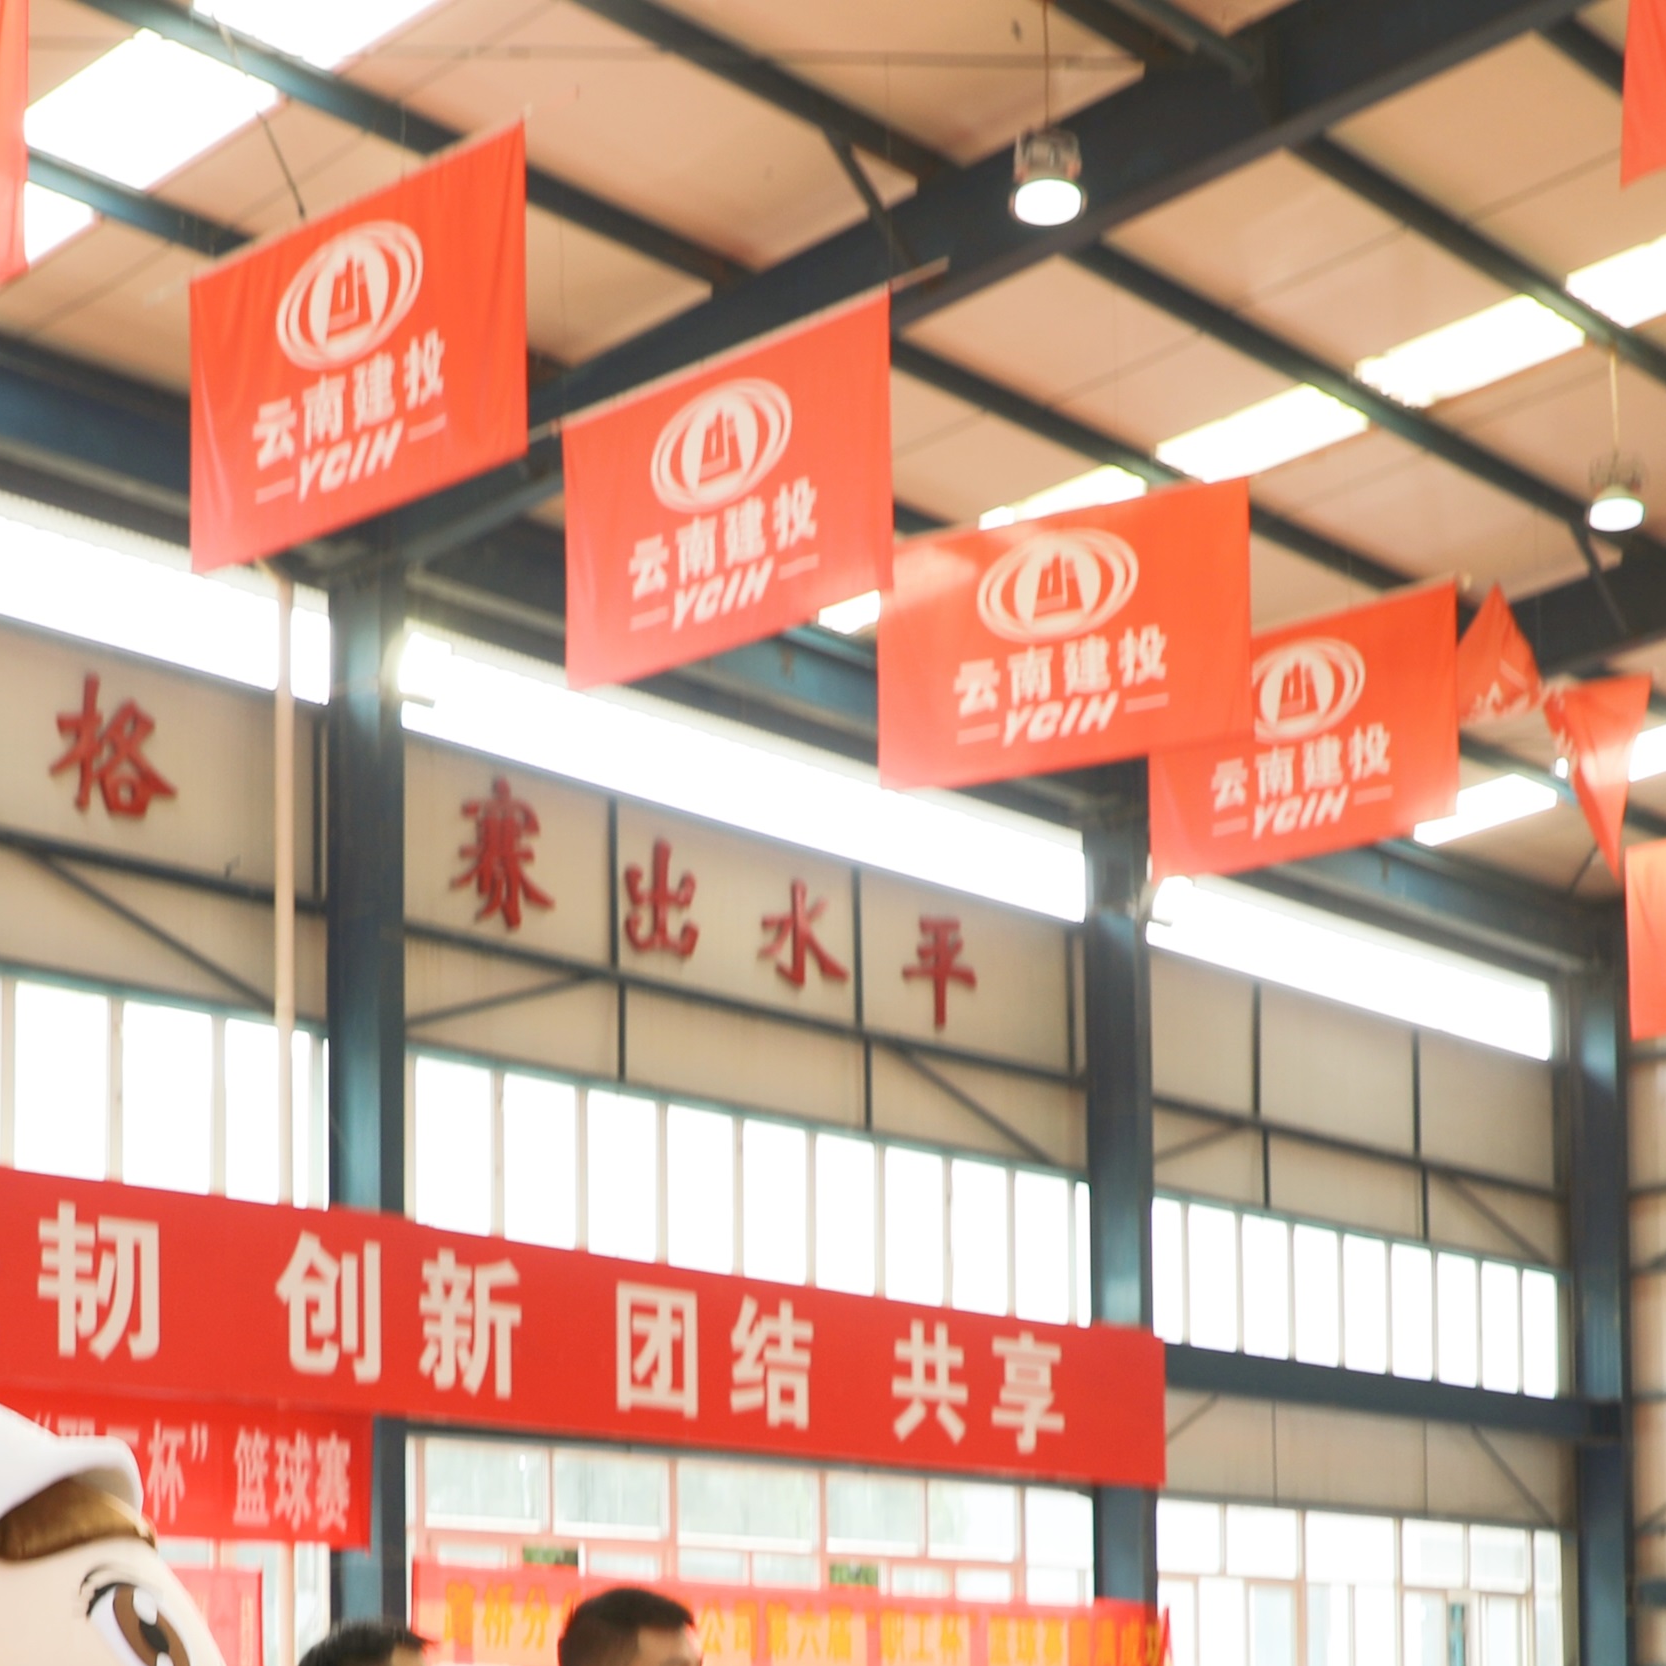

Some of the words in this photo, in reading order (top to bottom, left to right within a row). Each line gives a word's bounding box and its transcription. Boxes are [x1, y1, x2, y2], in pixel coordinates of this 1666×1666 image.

[252, 326, 446, 469] 云南建投
[297, 419, 403, 504] YCIH
[628, 476, 819, 600] 云南建投
[672, 556, 775, 630] YCIH
[954, 623, 1168, 714] 云南建投
[1001, 689, 1120, 747] YCIH
[1210, 719, 1391, 804] 云南建投
[1251, 783, 1348, 840] YCIH
[451, 777, 977, 1031] 赛出水平
[276, 1229, 523, 1398] 创新
[614, 1278, 814, 1428] 团结
[890, 1317, 1067, 1455] 共享
